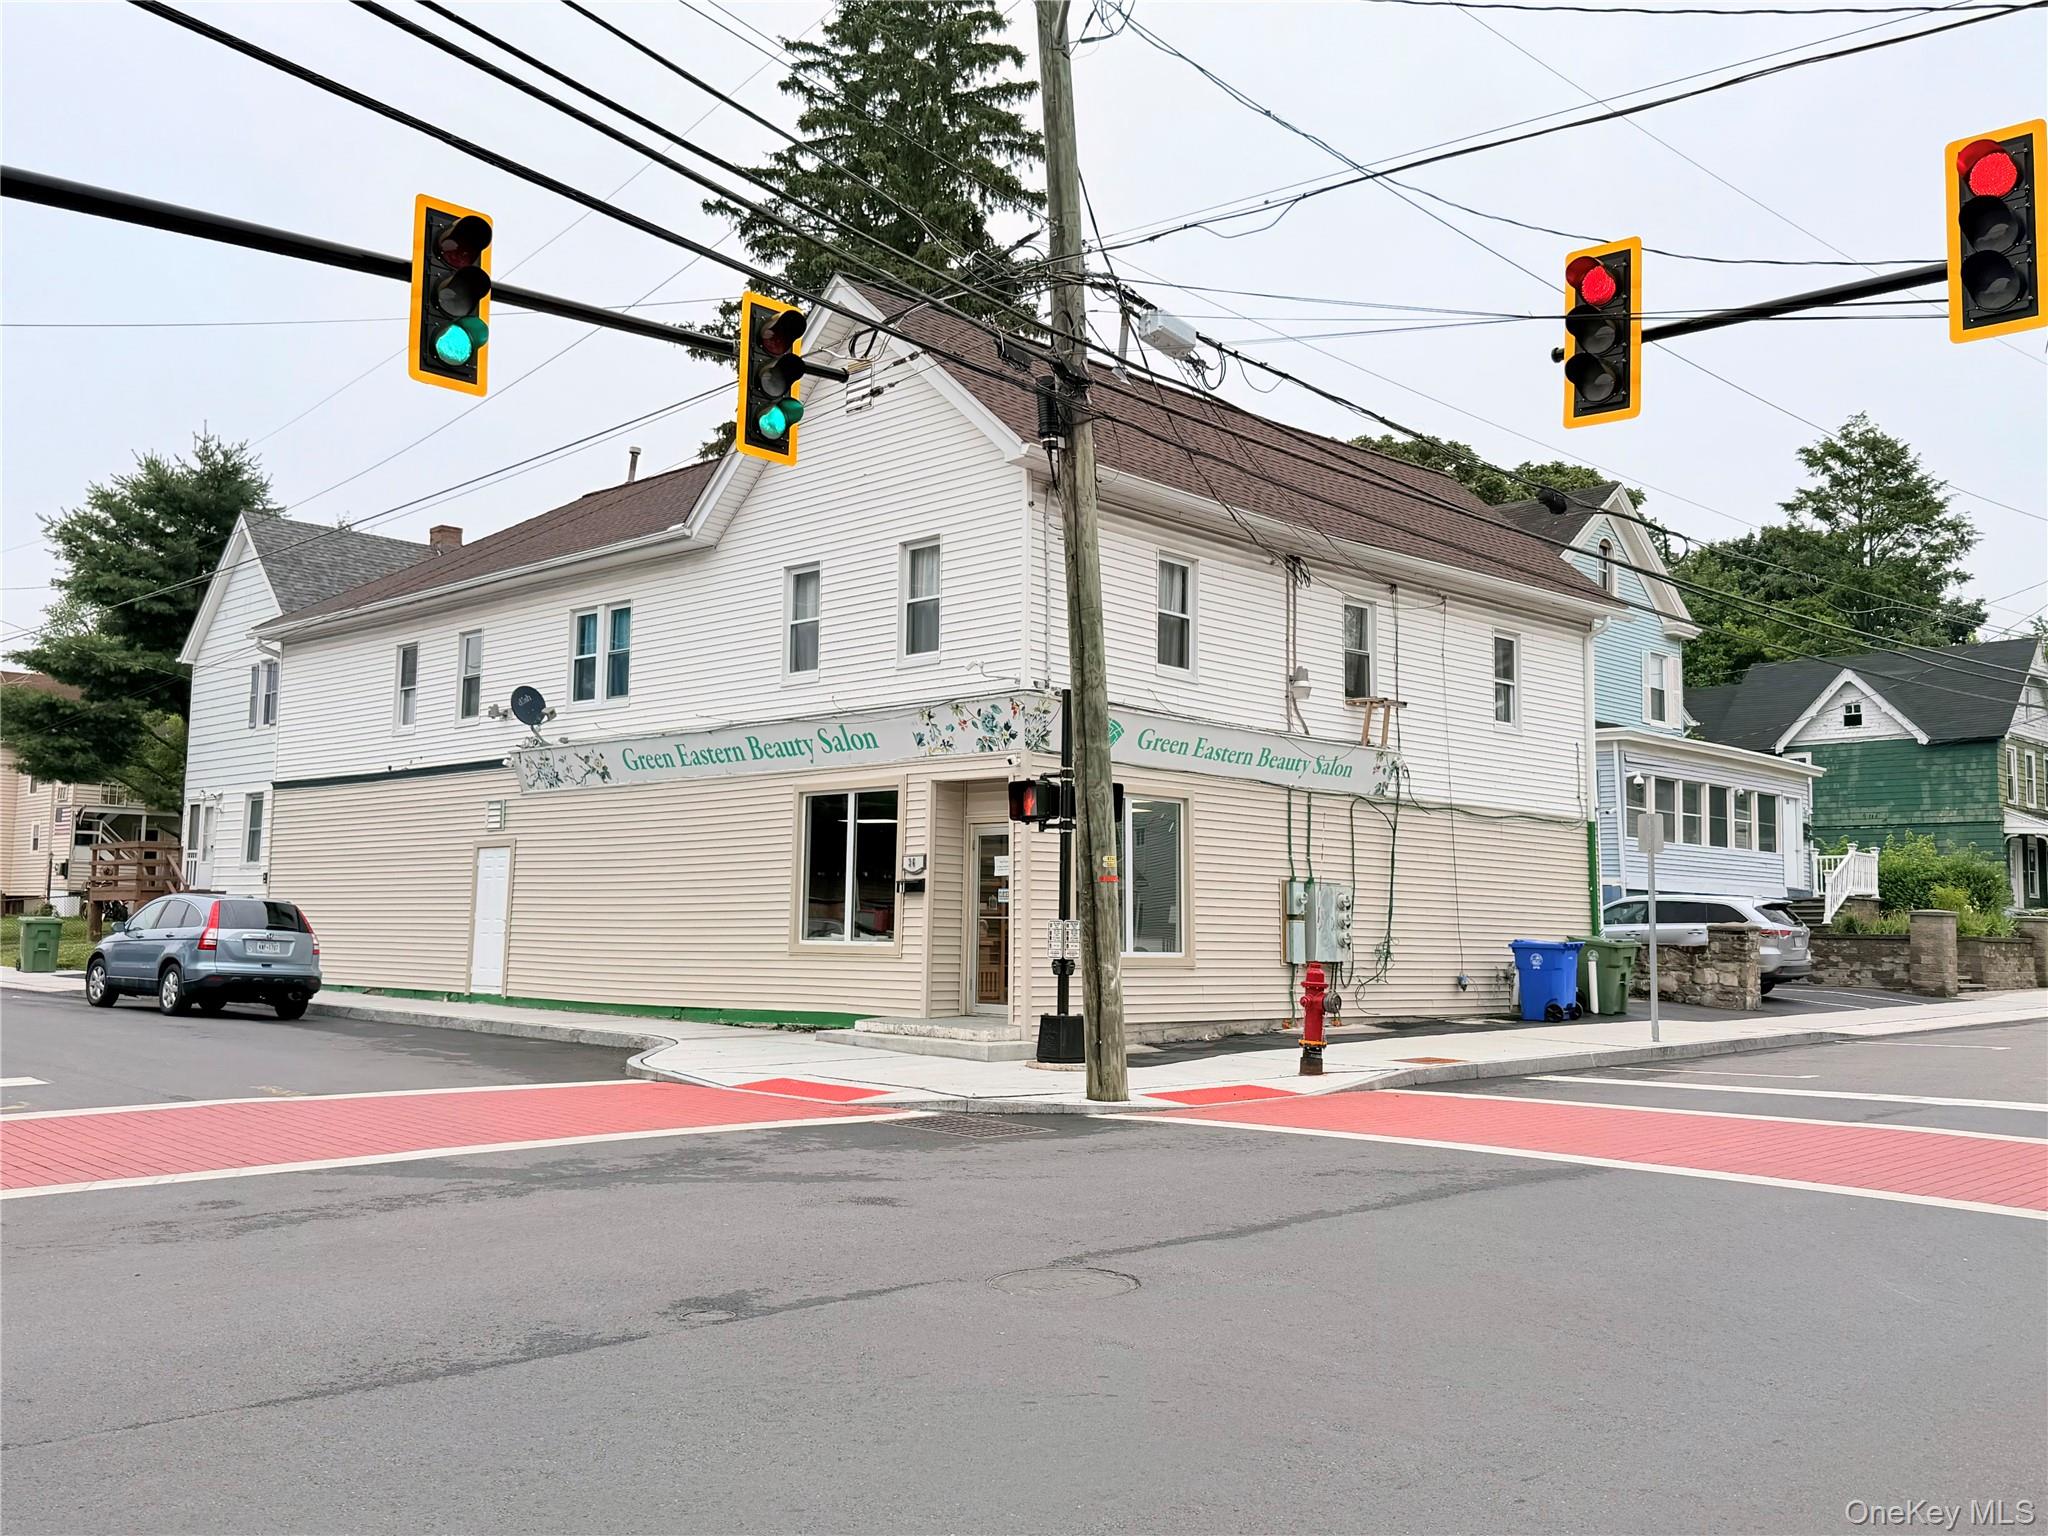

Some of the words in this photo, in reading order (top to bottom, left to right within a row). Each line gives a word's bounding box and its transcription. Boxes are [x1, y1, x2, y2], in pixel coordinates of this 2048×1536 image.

[622, 747, 676, 772] Green
[674, 743, 746, 767] Eastern
[745, 735, 814, 764] Beauty
[816, 723, 880, 754] Salon
[1137, 728, 1189, 756] Green
[1191, 736, 1253, 766] Eastern
[1256, 747, 1311, 779] Beauty
[1312, 754, 1353, 778] Salon
